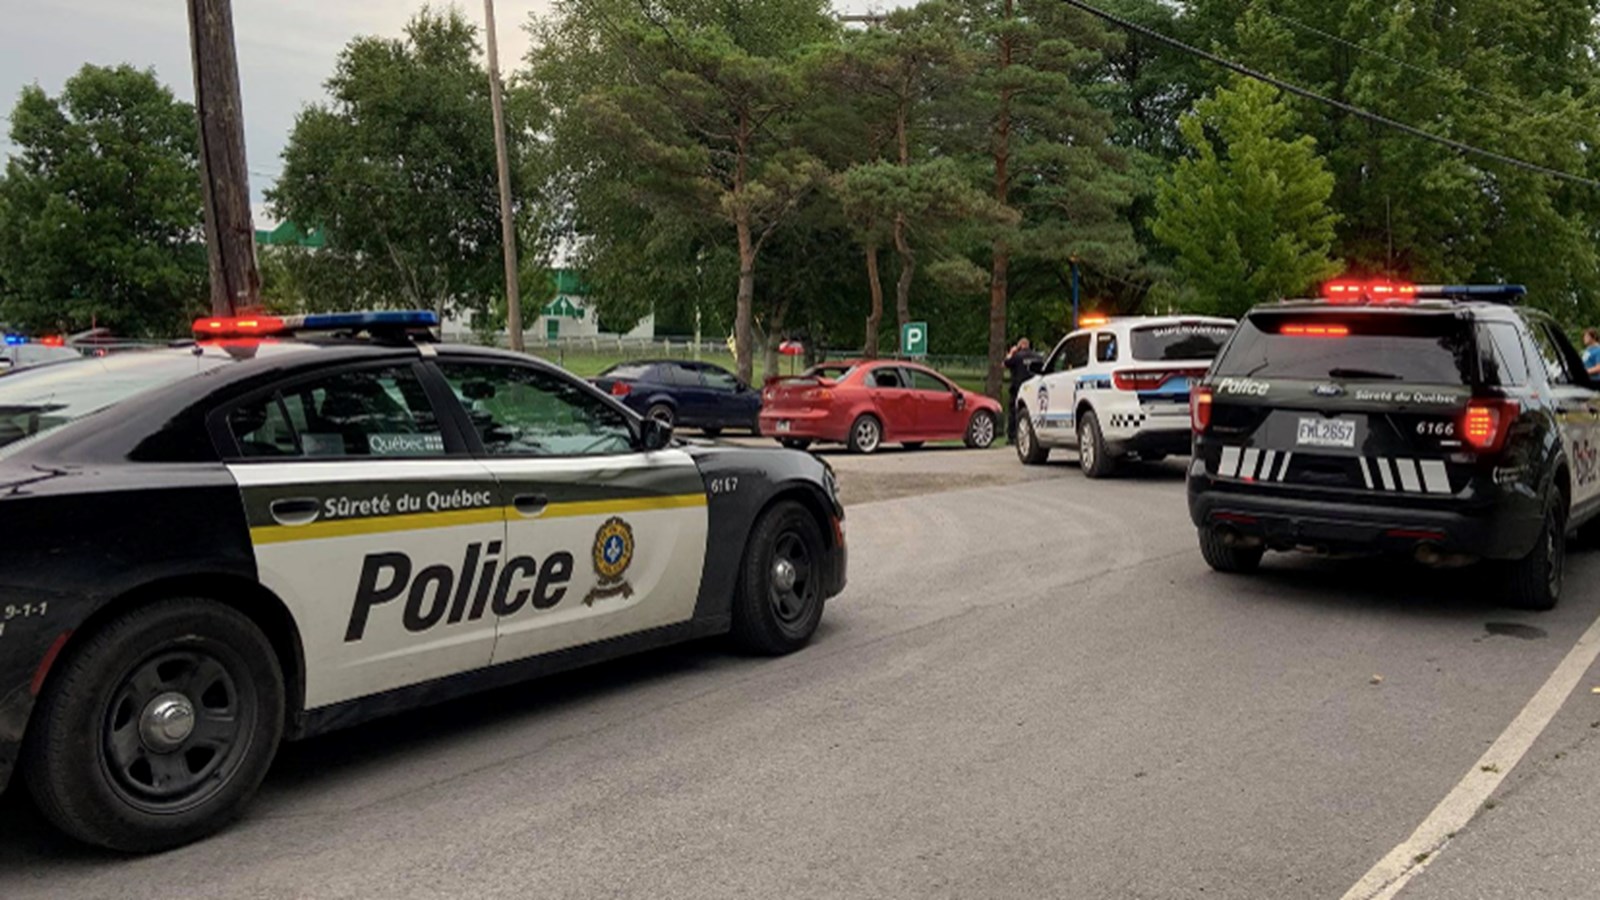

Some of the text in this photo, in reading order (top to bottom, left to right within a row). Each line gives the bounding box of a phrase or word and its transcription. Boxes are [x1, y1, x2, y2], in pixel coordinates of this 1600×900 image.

[907, 328, 922, 350] P
[1217, 377, 1270, 396] Police
[1355, 389, 1392, 400] Sûreté
[1394, 391, 1411, 402] du
[1416, 421, 1455, 435] 6166
[369, 434, 424, 454] Québec
[711, 476, 738, 494] 6167
[324, 488, 492, 518] Sûreté du Québec
[343, 539, 575, 643] Police
[4, 601, 48, 620] 9-1-1
